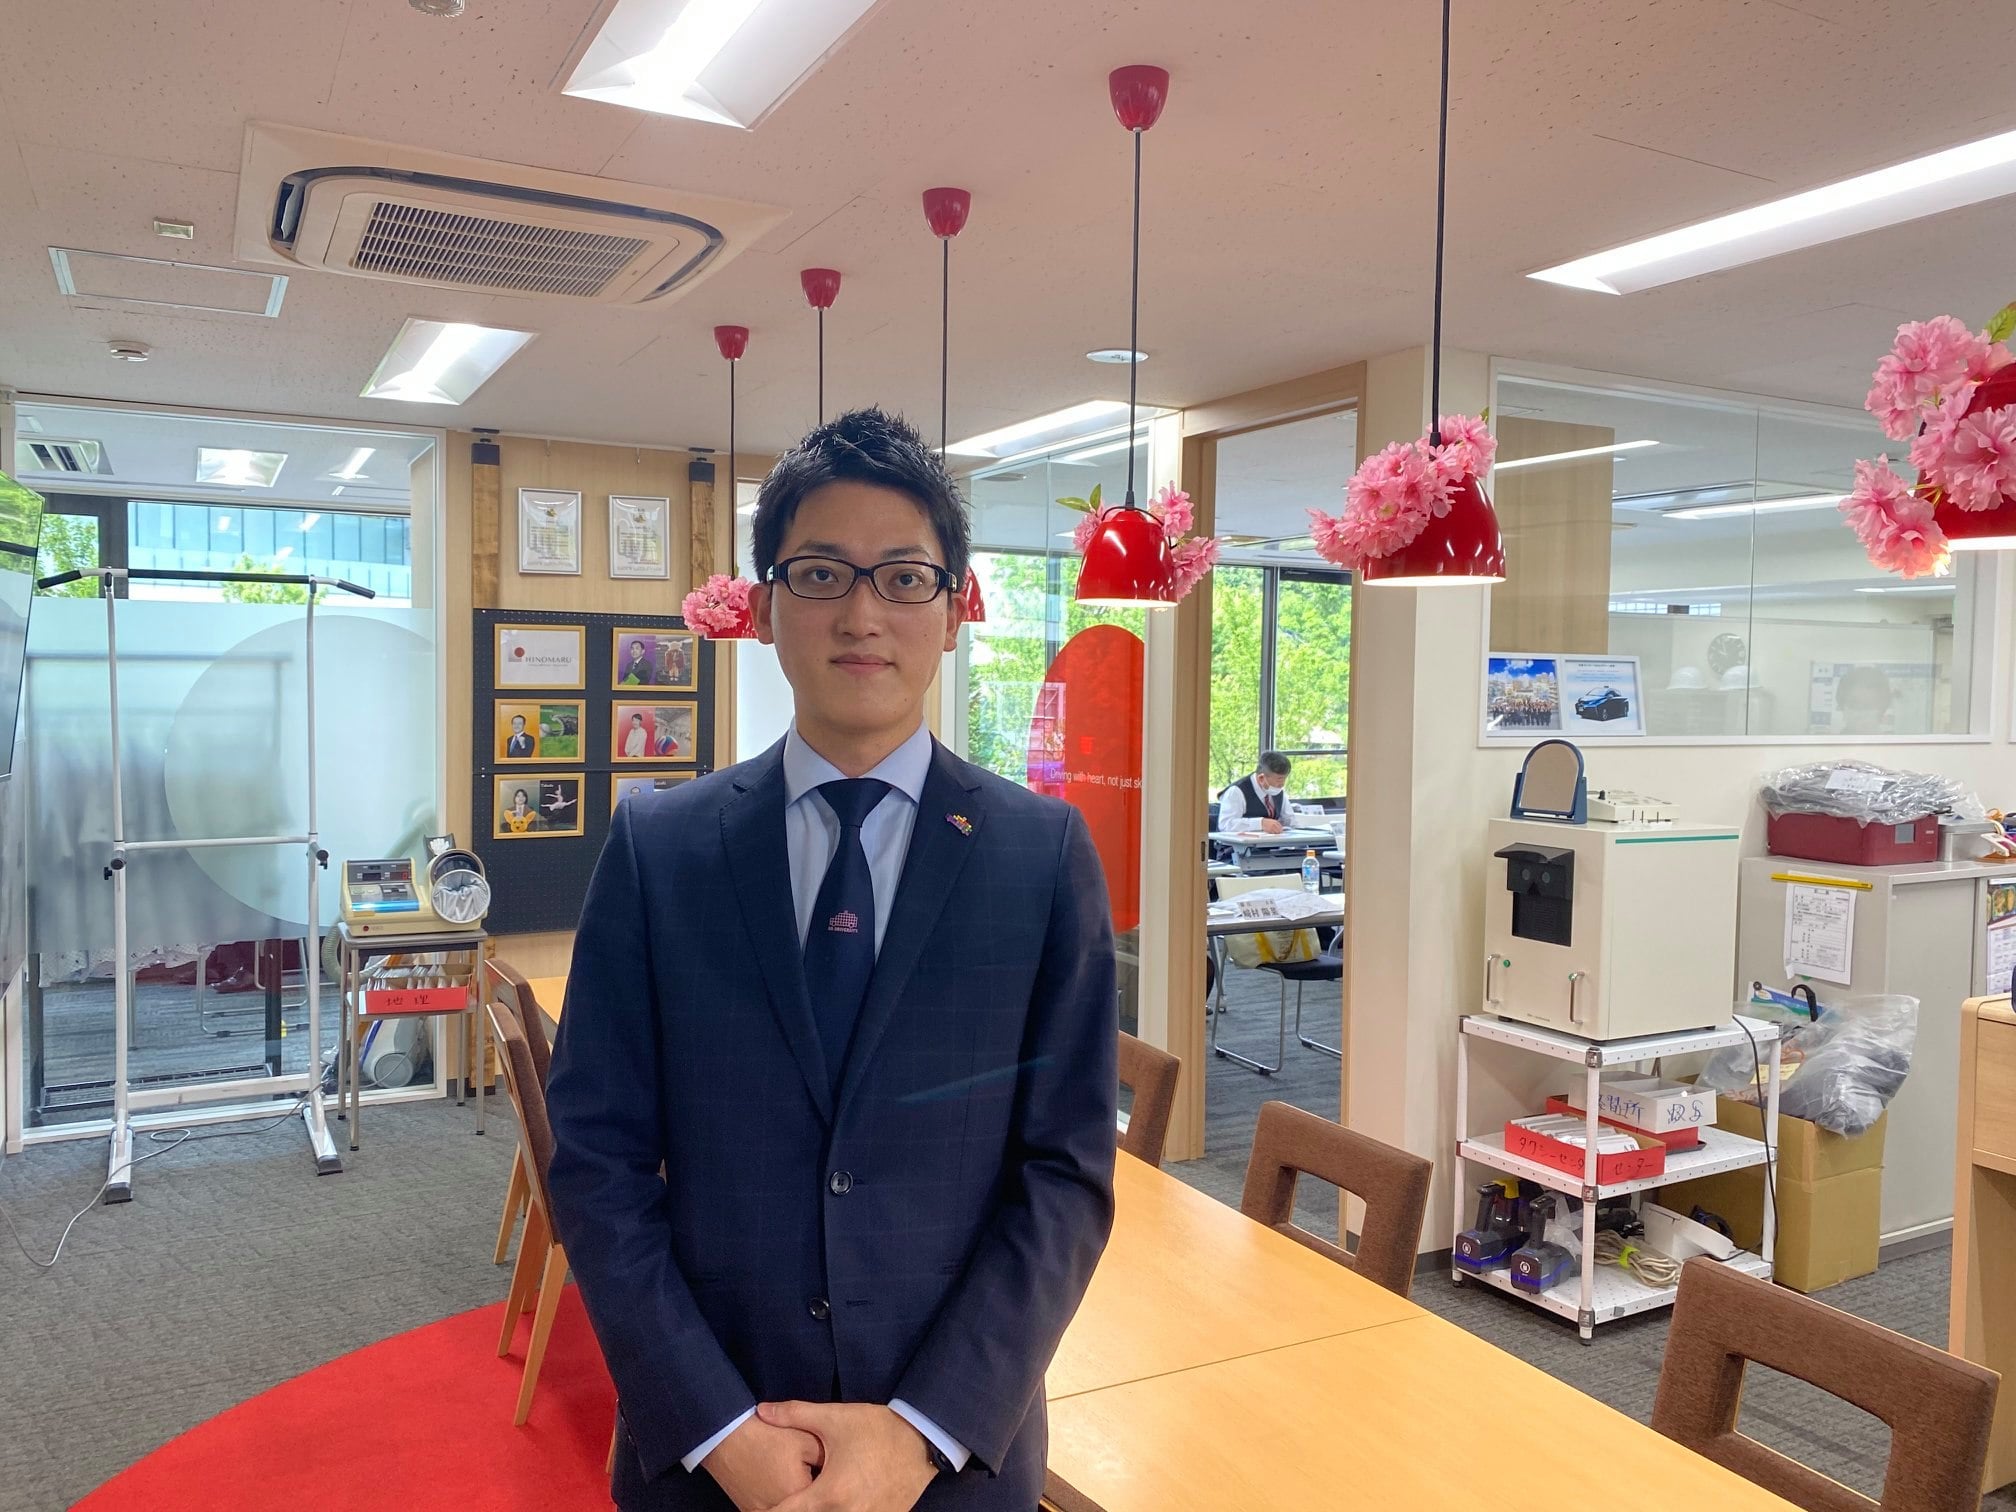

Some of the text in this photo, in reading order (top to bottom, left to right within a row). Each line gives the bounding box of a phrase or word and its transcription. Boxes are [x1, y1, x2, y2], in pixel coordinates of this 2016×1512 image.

[525, 656, 572, 664] HINOMARU
[1050, 768, 1072, 783] Driving
[1073, 771, 1086, 782] with
[1087, 772, 1106, 786] heart,
[1107, 776, 1118, 787] not
[1119, 776, 1132, 790] just
